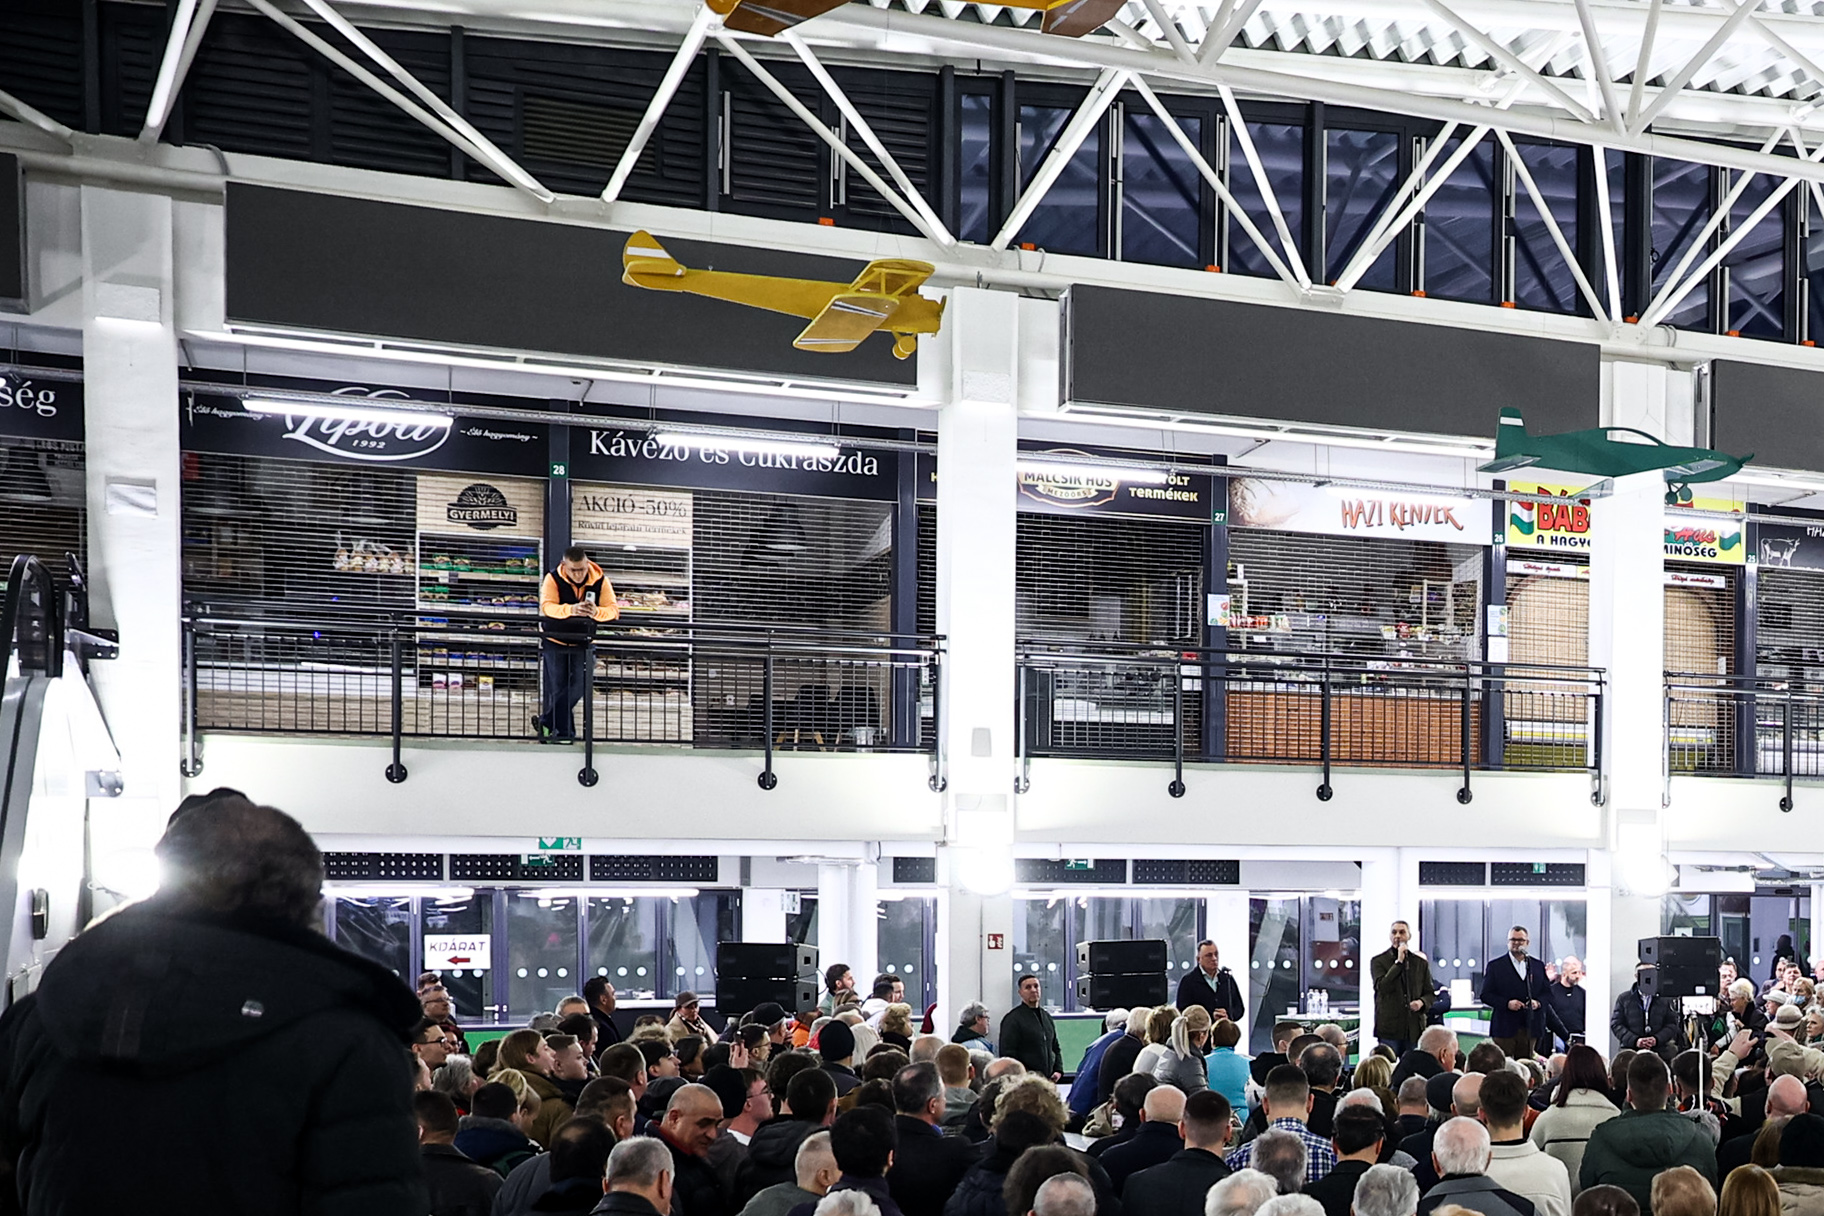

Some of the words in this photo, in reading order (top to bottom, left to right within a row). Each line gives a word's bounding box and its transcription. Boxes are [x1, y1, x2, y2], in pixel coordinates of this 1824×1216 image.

[352, 439, 386, 449] 1992
[553, 464, 566, 475] 28
[578, 494, 636, 514] AKCIÓ
[449, 509, 515, 521] GYERMELYI
[1214, 512, 1225, 522] 27
[1494, 533, 1504, 543] 26
[1537, 534, 1545, 545] A
[1550, 535, 1590, 547] HAGY
[1747, 554, 1756, 563] 25
[429, 938, 486, 952] KIJÁRAT
